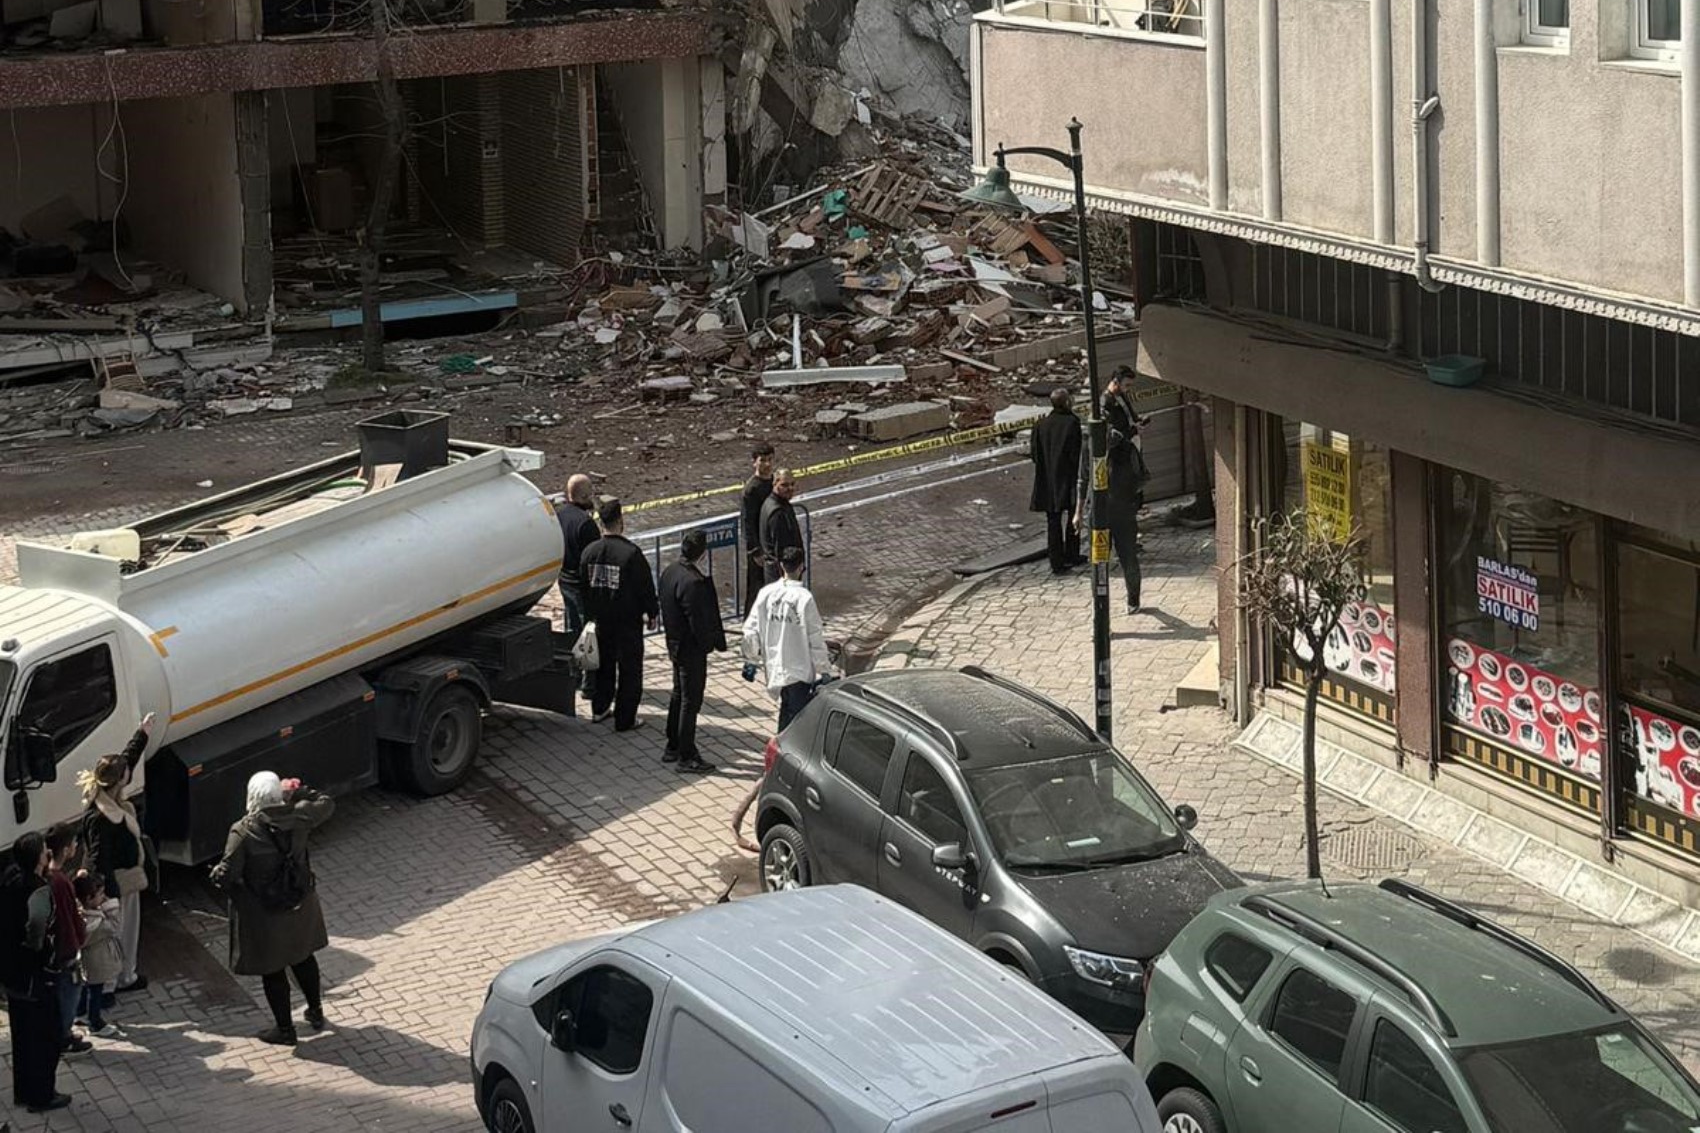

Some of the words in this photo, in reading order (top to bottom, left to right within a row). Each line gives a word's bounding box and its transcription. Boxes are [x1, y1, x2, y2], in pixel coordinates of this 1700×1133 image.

[1310, 449, 1345, 476] SATILIK
[706, 529, 733, 543] BITA
[1478, 555, 1537, 586] BARLAS'dan
[1479, 577, 1536, 612] SATILIK
[1479, 597, 1500, 617] 510
[1504, 606, 1519, 624] 06
[1522, 612, 1537, 631] 00
[936, 866, 976, 895] STEPWAY
